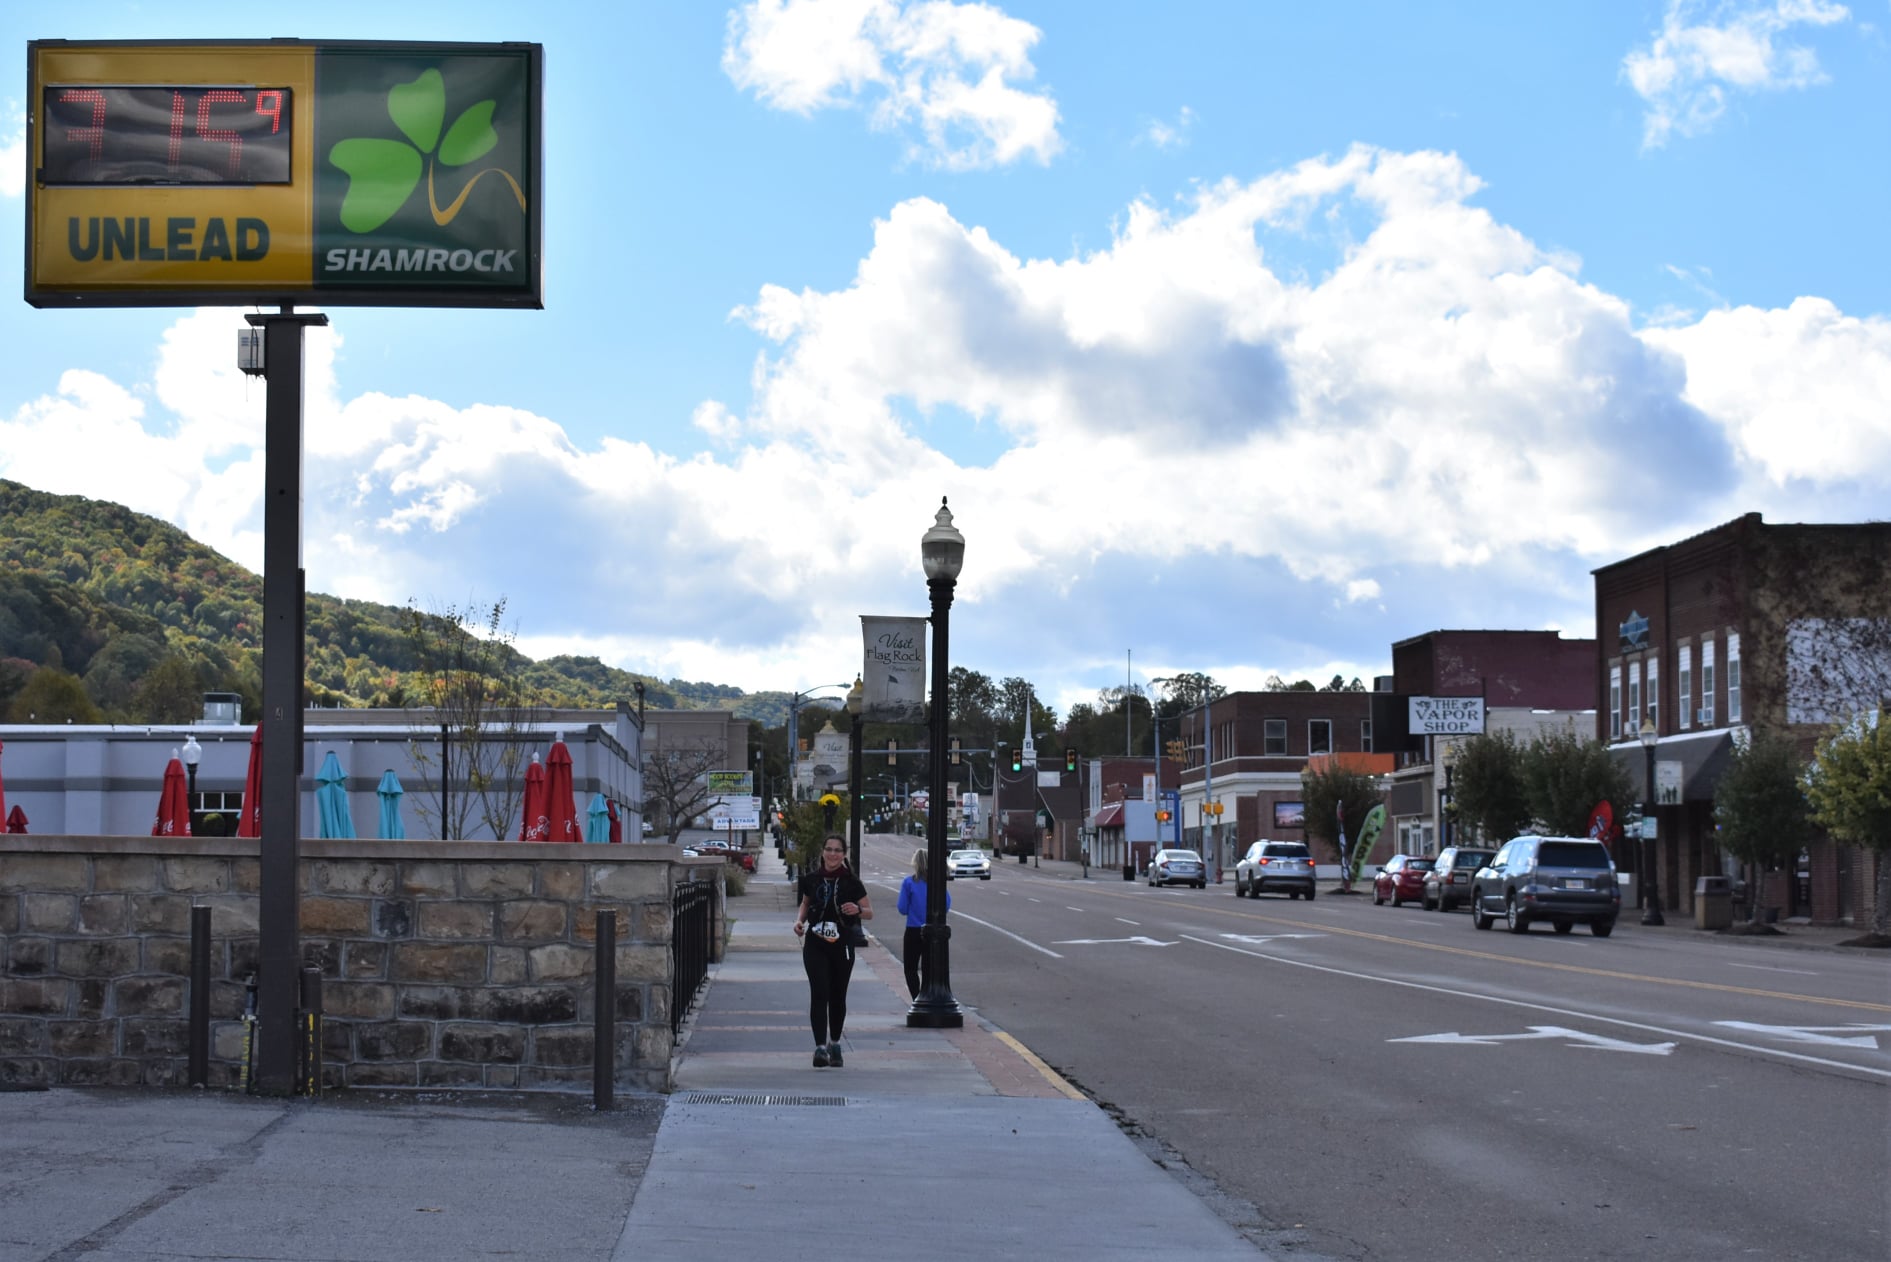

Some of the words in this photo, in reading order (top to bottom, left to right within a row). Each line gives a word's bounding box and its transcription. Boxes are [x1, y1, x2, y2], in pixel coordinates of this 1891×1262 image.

[66, 216, 271, 262] UNLEAD
[324, 247, 518, 273] SHAMROCK
[878, 632, 914, 648] Visit
[866, 645, 892, 665] Flag
[893, 648, 923, 662] Rock
[1432, 699, 1459, 709] THE
[1415, 709, 1479, 721] VAPOR
[1424, 721, 1470, 732] SHOP
